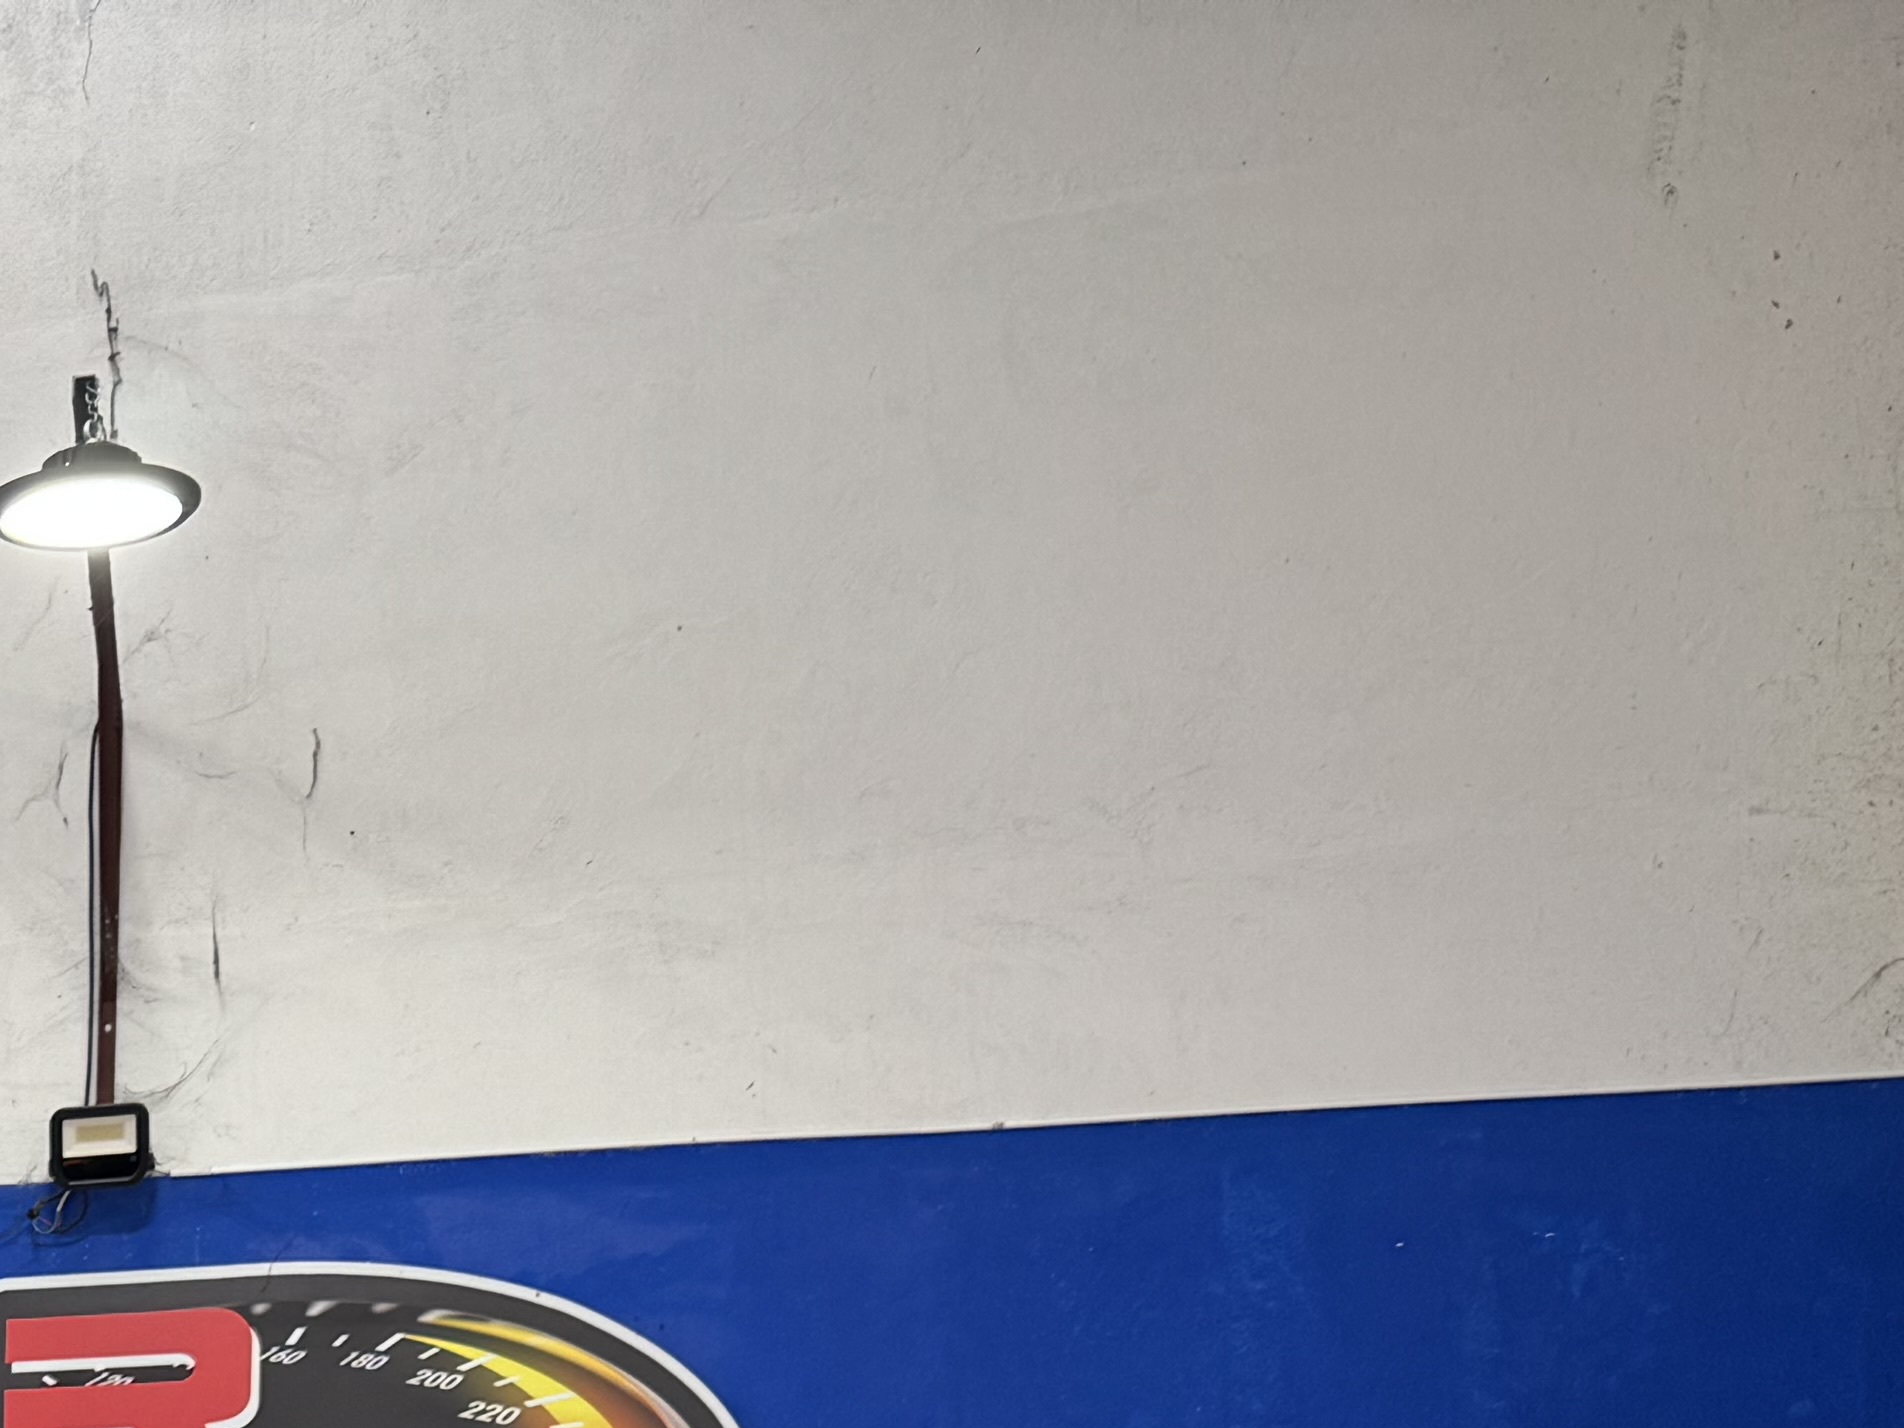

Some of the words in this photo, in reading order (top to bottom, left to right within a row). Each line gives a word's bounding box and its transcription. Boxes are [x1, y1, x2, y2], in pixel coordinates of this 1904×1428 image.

[259, 1346, 308, 1365] 160
[339, 1350, 391, 1371] 180
[405, 1368, 465, 1391] 200
[457, 1400, 522, 1426] 220
